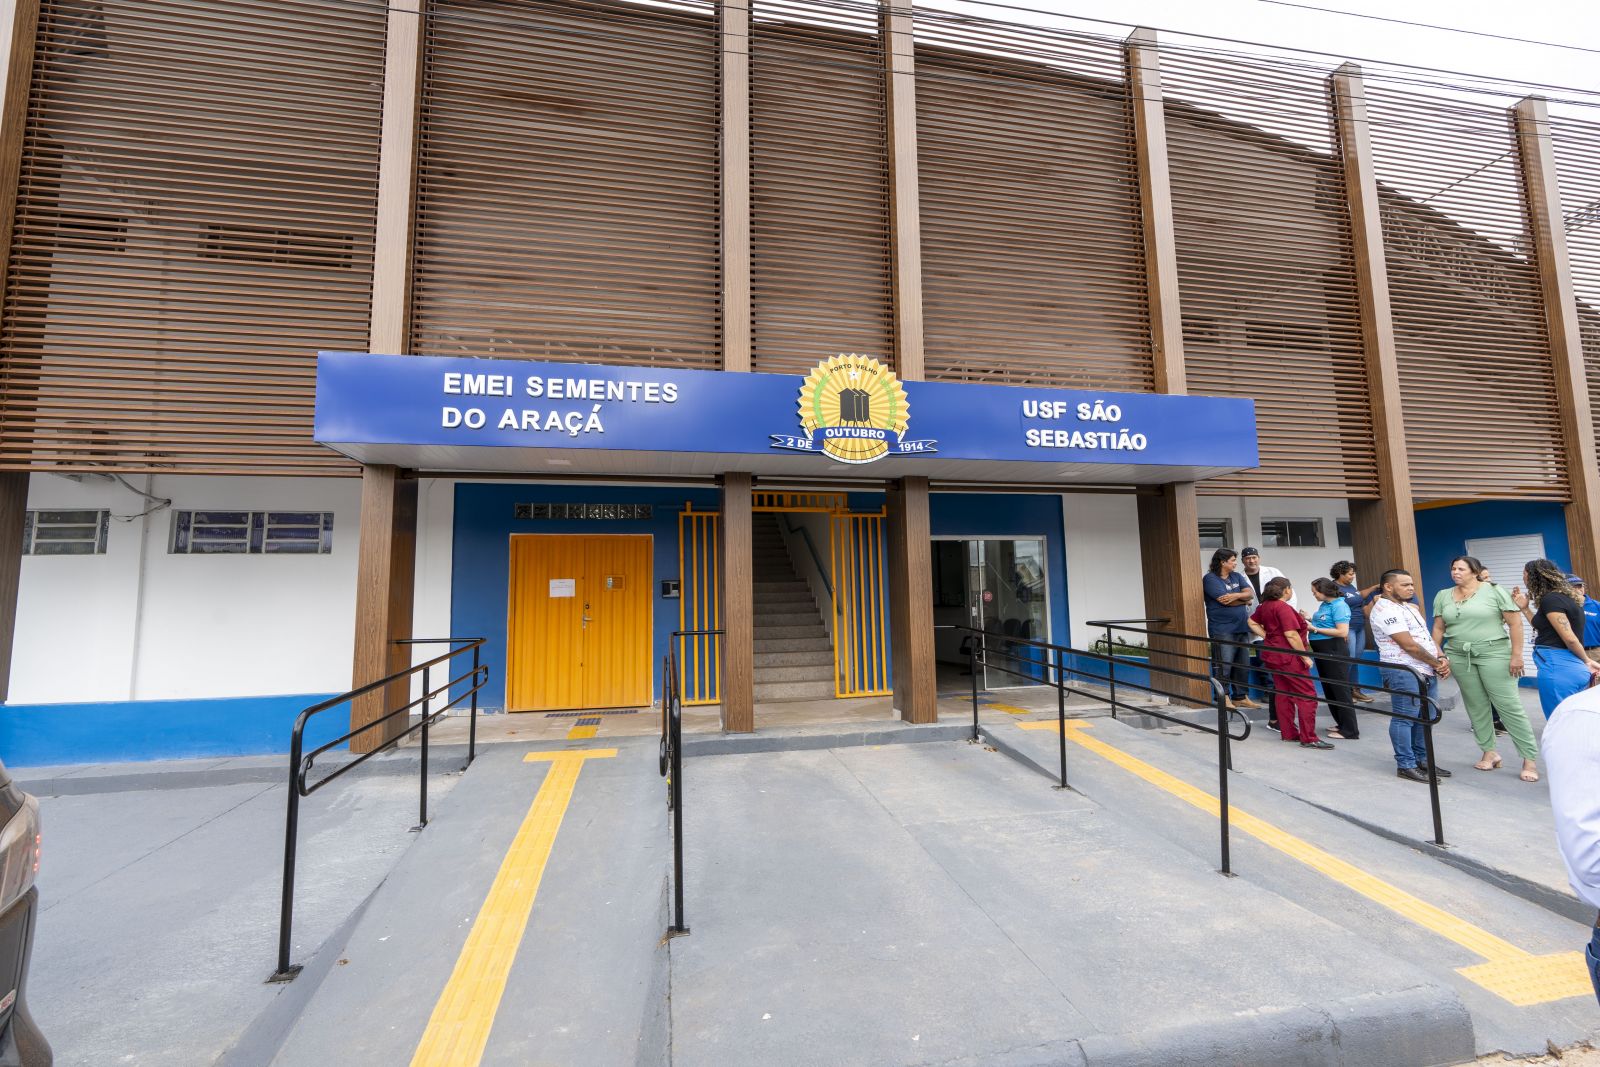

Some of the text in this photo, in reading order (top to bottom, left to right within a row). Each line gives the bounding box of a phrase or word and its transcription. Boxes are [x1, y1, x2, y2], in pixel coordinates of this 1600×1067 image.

[829, 363, 878, 376] PORTO VELHO
[443, 372, 679, 403] EMEI SEMENTES
[1022, 400, 1122, 422] USF SÃO
[441, 405, 605, 436] DO ARAÇÁ
[825, 427, 886, 439] OUTUBRO
[1025, 428, 1147, 451] SEBASTIÃO
[787, 438, 813, 449] 2 DE
[898, 442, 924, 452] 1914
[1383, 616, 1398, 626] USF
